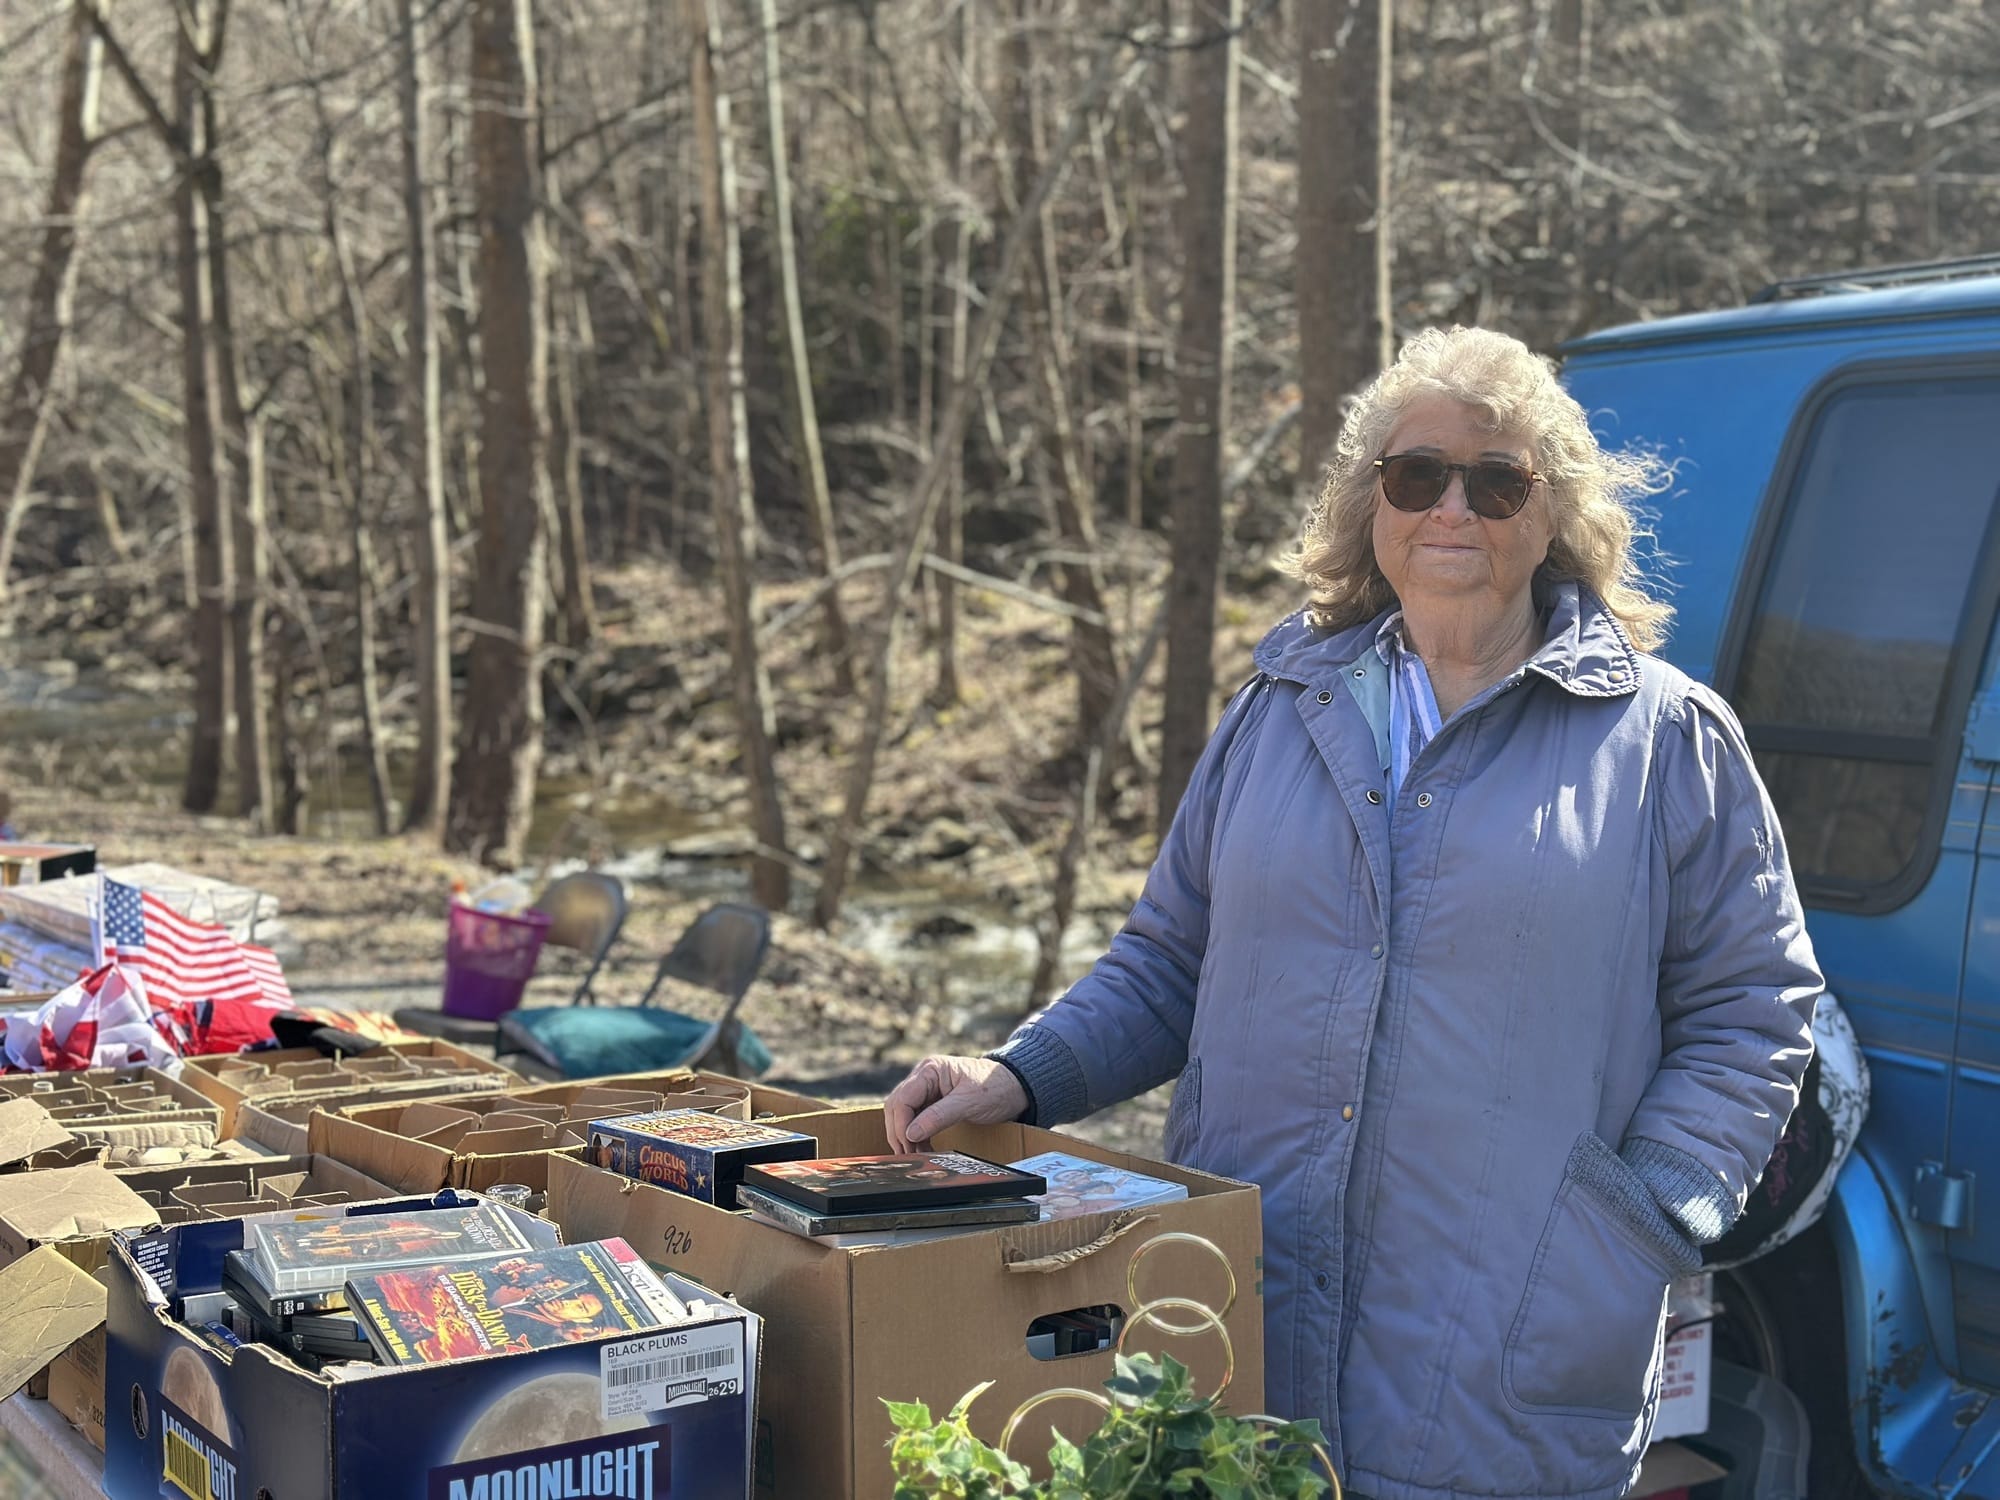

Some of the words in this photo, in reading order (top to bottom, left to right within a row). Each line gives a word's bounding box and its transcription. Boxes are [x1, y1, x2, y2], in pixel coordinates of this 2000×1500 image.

[640, 1145, 687, 1175] CIRCUS
[638, 1164, 689, 1191] WORLD
[449, 1270, 487, 1305] DUSK
[475, 1307, 515, 1346] DAWN
[607, 1341, 646, 1358] BLACK
[648, 1334, 689, 1352] PLUMS
[667, 1380, 706, 1401] MOONLIGHT
